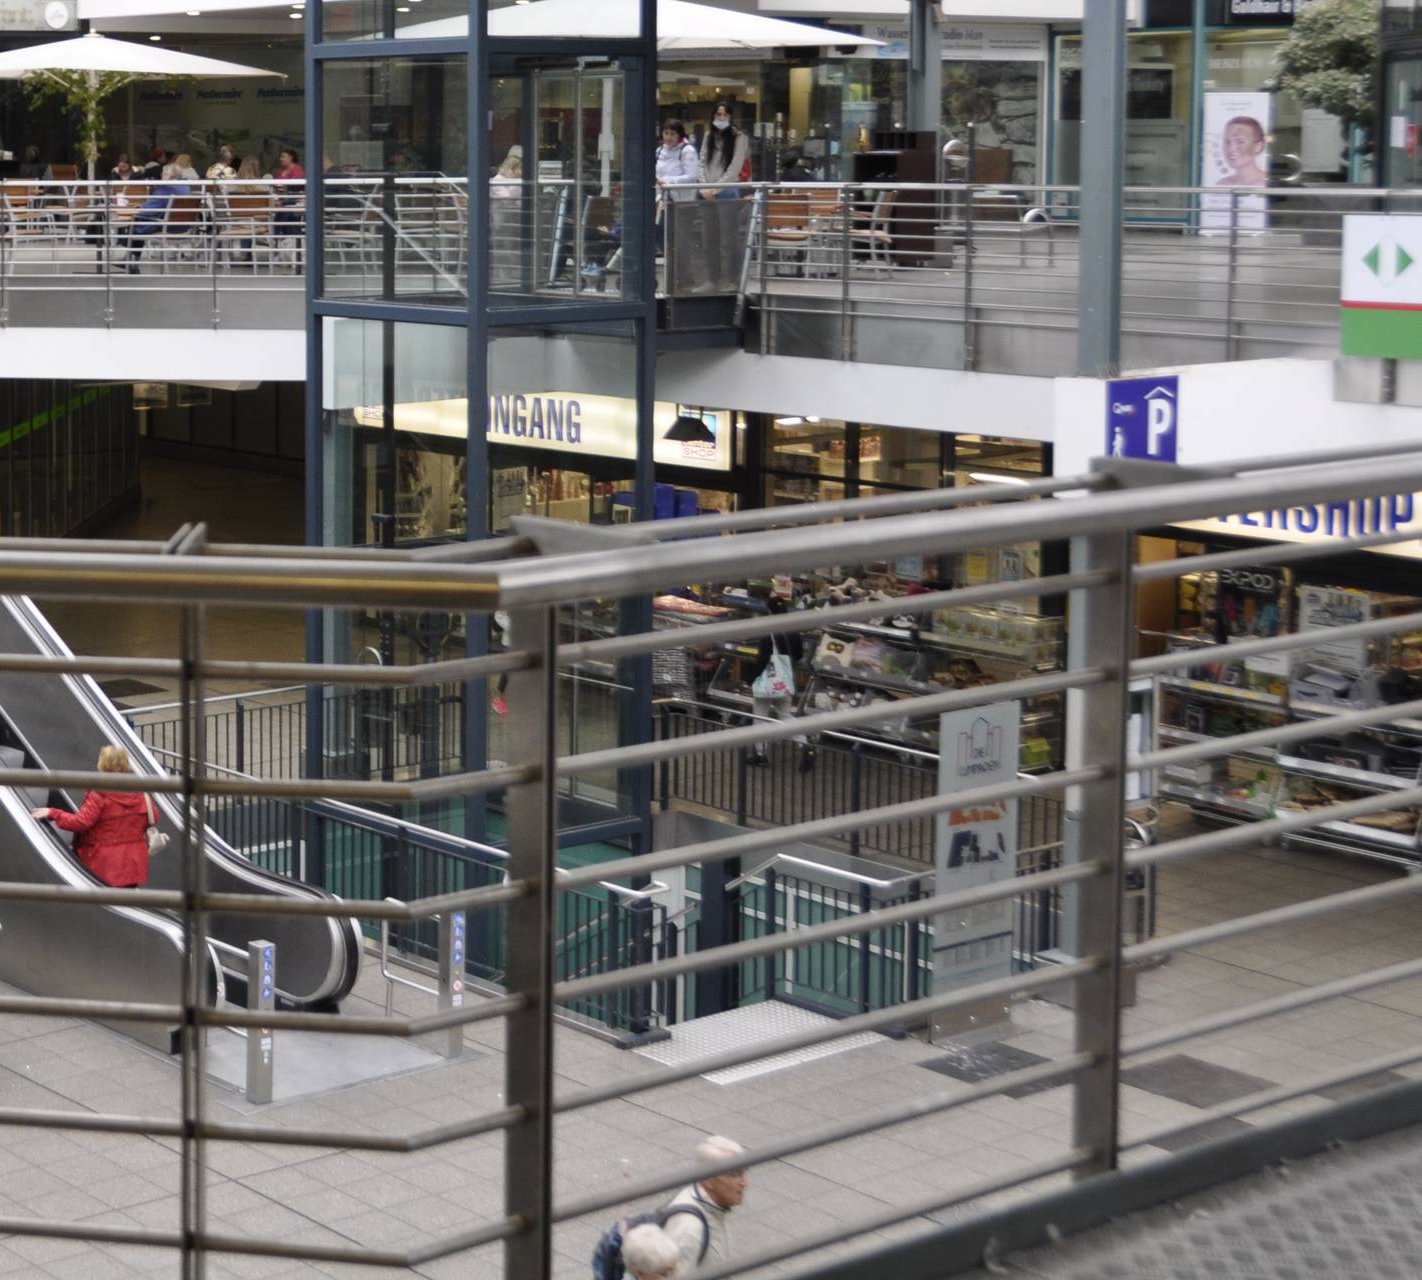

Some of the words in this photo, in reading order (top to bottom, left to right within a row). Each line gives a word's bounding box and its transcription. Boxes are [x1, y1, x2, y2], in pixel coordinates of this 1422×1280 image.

[486, 391, 582, 444] INGANG
[1146, 398, 1172, 455] P
[683, 447, 716, 458] SHOP
